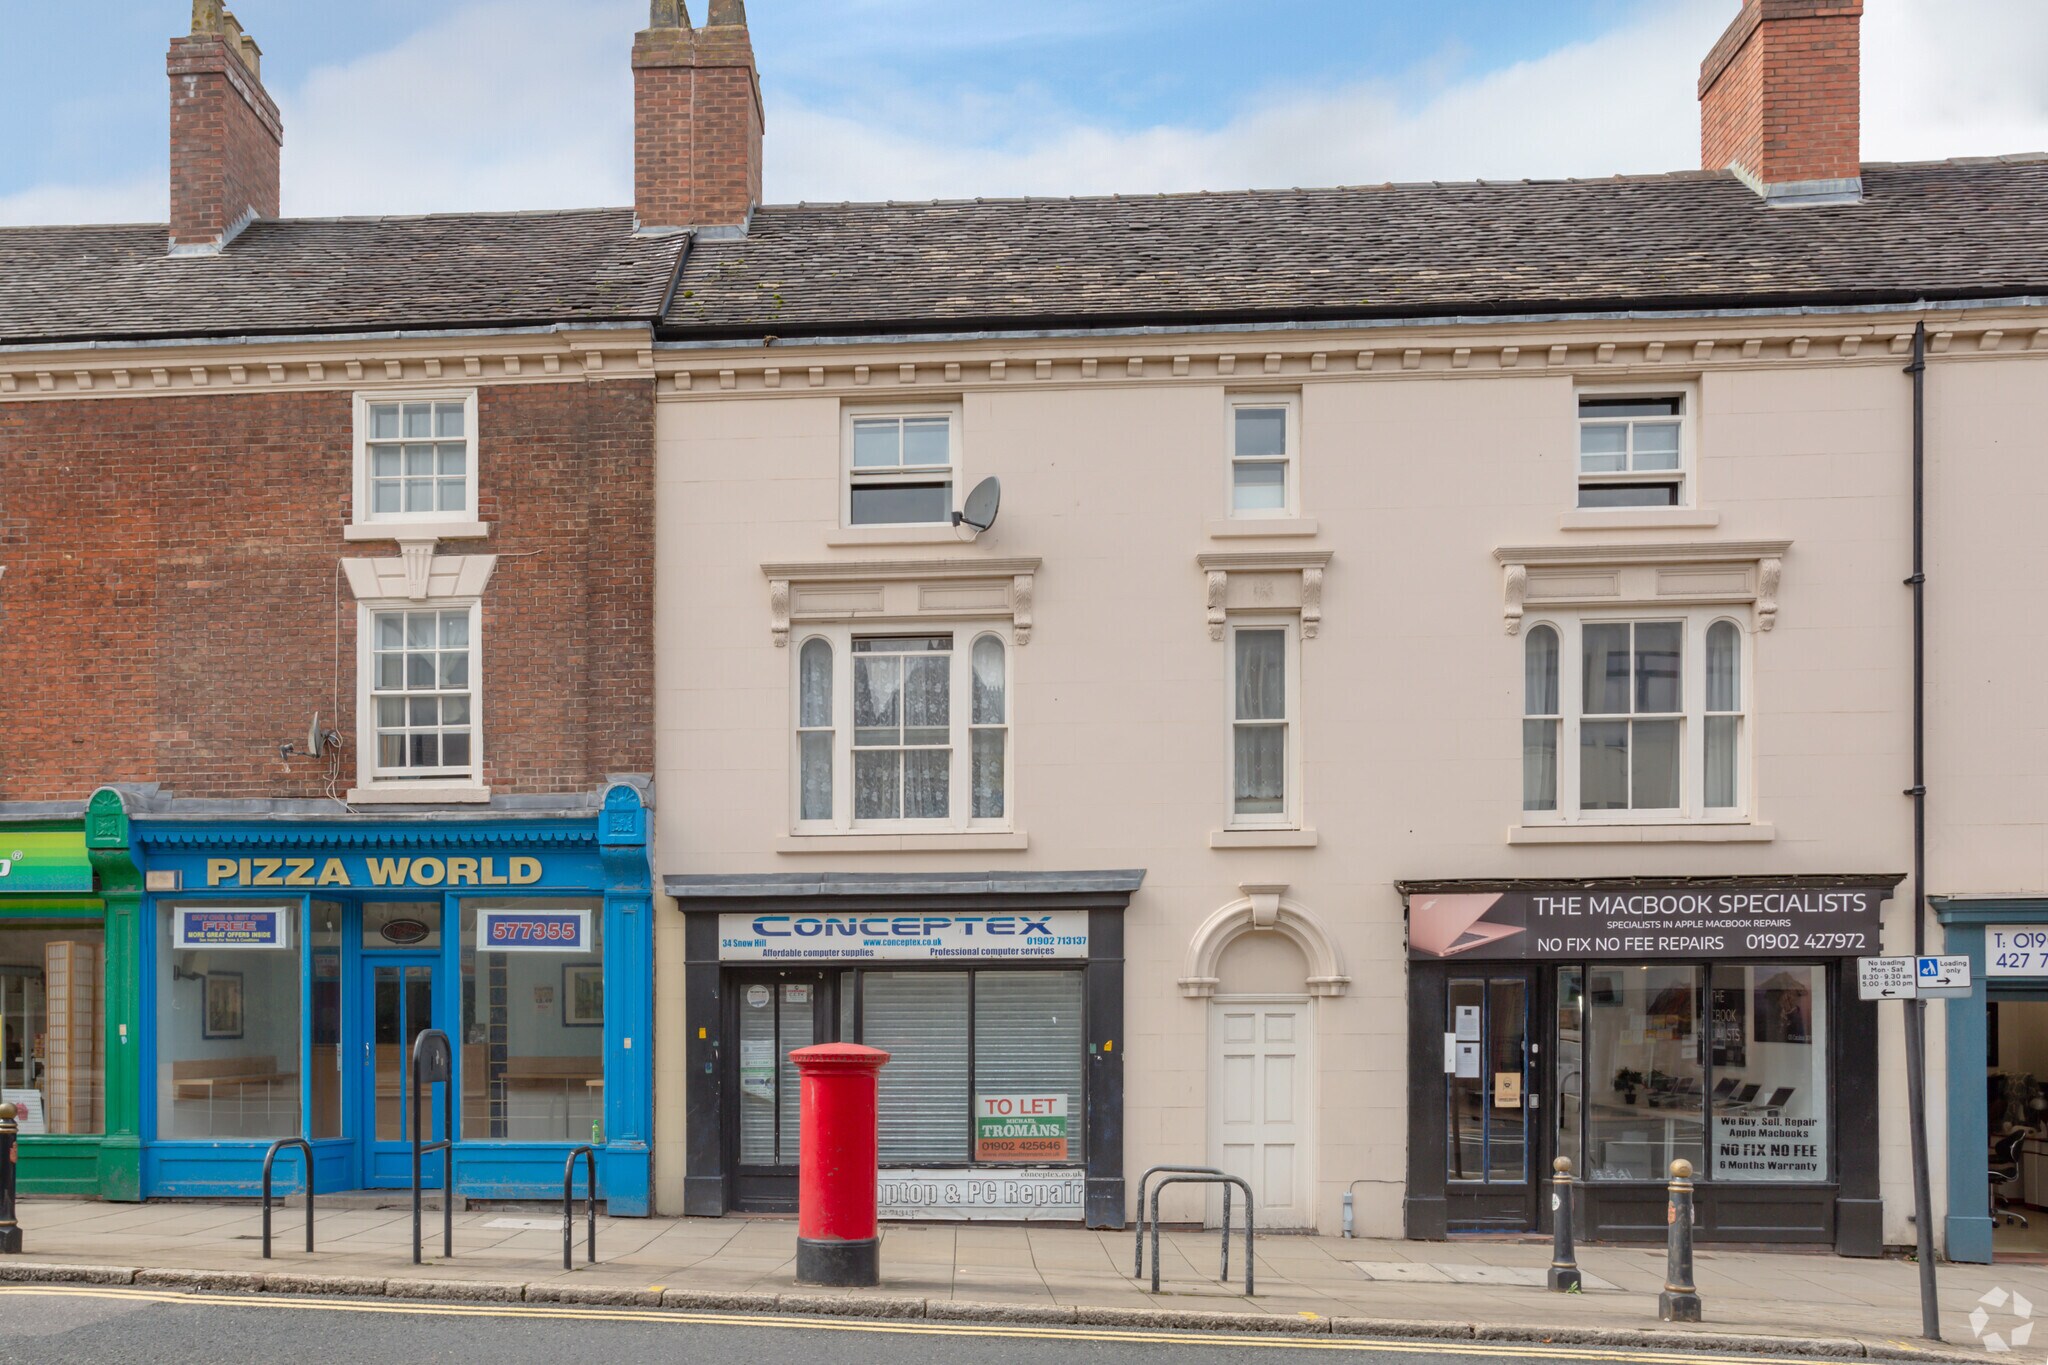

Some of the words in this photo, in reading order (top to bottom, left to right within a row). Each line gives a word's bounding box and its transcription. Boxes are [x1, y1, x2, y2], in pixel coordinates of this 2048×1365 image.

[207, 858, 350, 886] PIZZA
[366, 857, 542, 886] WORLD
[1533, 897, 1581, 915] THE
[1590, 895, 1712, 915] MACBOOK
[1718, 893, 1866, 913] SPECIALISTS
[203, 921, 256, 931] FREE
[752, 916, 1053, 937] CONCEPTEX
[1607, 921, 1661, 929] SPECIALISTS
[1675, 920, 1704, 928] APPLE
[1706, 920, 1751, 928] MACBOOK
[1753, 919, 1791, 927] REPAIRS
[492, 922, 575, 940] 577355
[722, 939, 732, 947] 34
[733, 939, 753, 947] Snow
[754, 939, 767, 947] Hill
[863, 938, 942, 948] www.conceptex.co.uk
[1026, 936, 1055, 945] 01902
[1057, 936, 1087, 945] 713137
[1537, 938, 1562, 951] NO
[1566, 938, 1591, 951] FIX
[1595, 938, 1620, 951] NO
[1624, 937, 1654, 950] FEE
[1658, 936, 1724, 950] REPAIRS
[1746, 934, 1799, 949] 01902
[1804, 933, 1866, 948] 427972
[1994, 933, 2006, 948] T:
[762, 949, 802, 957] Affordable
[803, 949, 840, 958] computer
[841, 949, 874, 958] supplies
[930, 947, 980, 956] Professional
[981, 948, 1020, 957] computer
[1021, 947, 1055, 955] services
[1996, 953, 2030, 968] 427
[985, 1099, 1013, 1115] TO
[1020, 1099, 1057, 1114] LET
[1722, 1118, 1737, 1126] We
[1785, 1118, 1817, 1127] Repair
[982, 1124, 1059, 1137] TROMANS
[1729, 1129, 1756, 1138] Apple
[1759, 1130, 1809, 1138] Macbooks
[982, 1142, 1015, 1151] 01902
[1019, 1142, 1061, 1151] 425646
[1721, 1144, 1739, 1156] NO
[1744, 1144, 1766, 1156] FIX
[1771, 1145, 1790, 1157] NO
[1794, 1145, 1818, 1157] FEE
[1720, 1161, 1726, 1169] 6
[1729, 1161, 1765, 1170] Months
[1768, 1162, 1818, 1172] Warranty
[945, 1184, 960, 1204] &
[968, 1181, 997, 1204] PC
[1004, 1181, 1084, 1206] Repair
[890, 1209, 920, 1217] 713137
